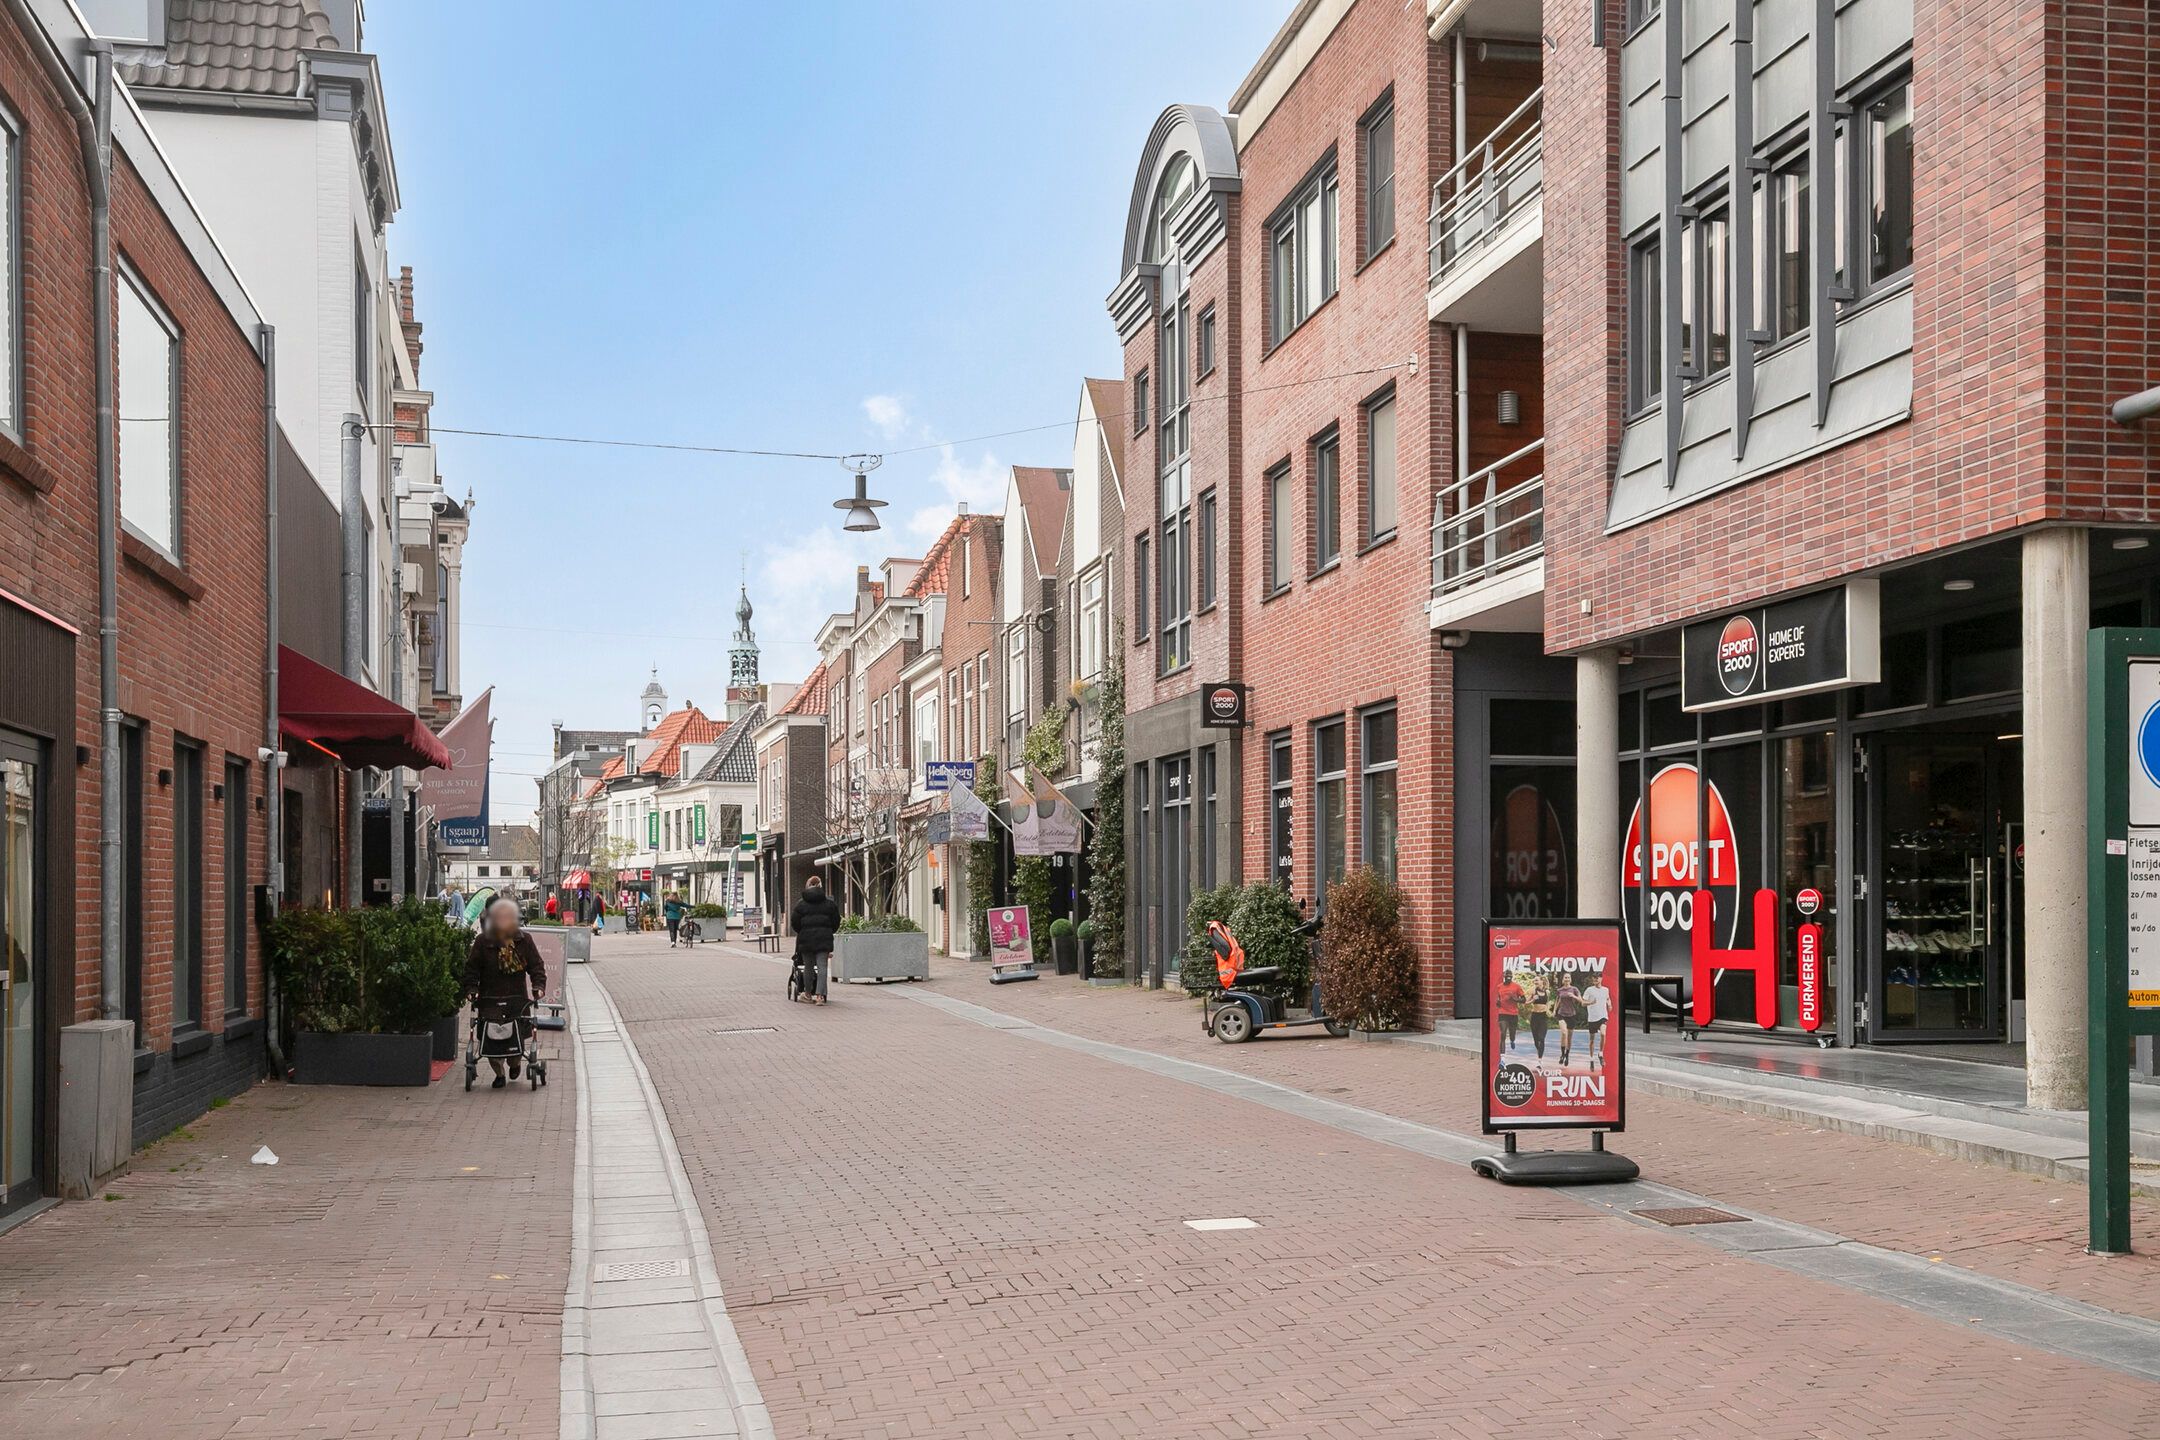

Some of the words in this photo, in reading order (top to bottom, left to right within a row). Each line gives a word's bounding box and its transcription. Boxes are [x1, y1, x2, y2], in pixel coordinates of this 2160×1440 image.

[1768, 628, 1794, 647] HOME
[1793, 625, 1805, 641] OF
[1721, 637, 1755, 657] SPORT
[1768, 643, 1805, 663] EXPERTS
[1724, 654, 1752, 673] 2000
[446, 779, 454, 787] &
[1052, 855, 1063, 867] 19
[2130, 912, 2138, 920] di
[1503, 954, 1531, 973] WE
[1535, 956, 1607, 973] KNOW
[1802, 934, 1815, 1021] PURMEREND
[1500, 1084, 1532, 1092] KORTING
[1546, 1075, 1606, 1098] RUN
[1573, 1099, 1606, 1107] 10-DAAGSE
